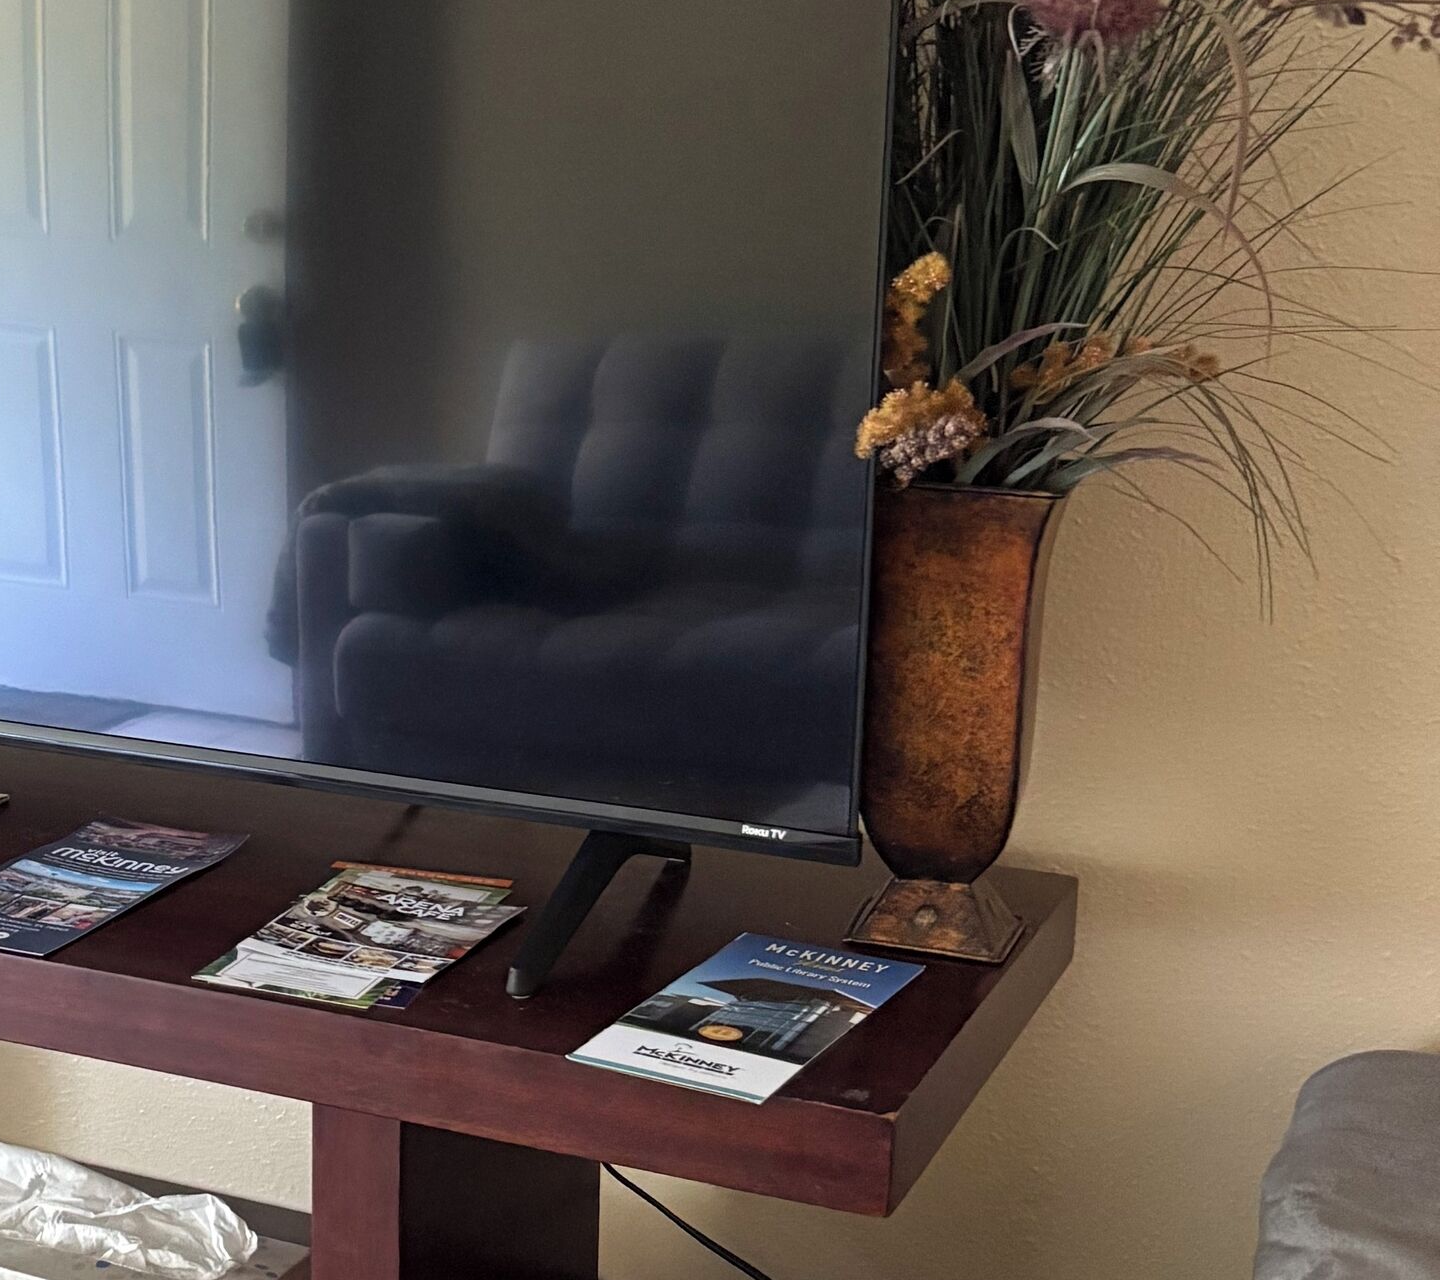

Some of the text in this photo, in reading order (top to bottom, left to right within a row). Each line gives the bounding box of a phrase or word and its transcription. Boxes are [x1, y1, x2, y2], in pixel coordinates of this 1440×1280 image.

[769, 828, 787, 840] TV
[376, 893, 465, 917] ARENA
[747, 958, 785, 972] Public
[785, 966, 828, 980] Library
[827, 975, 872, 989] System
